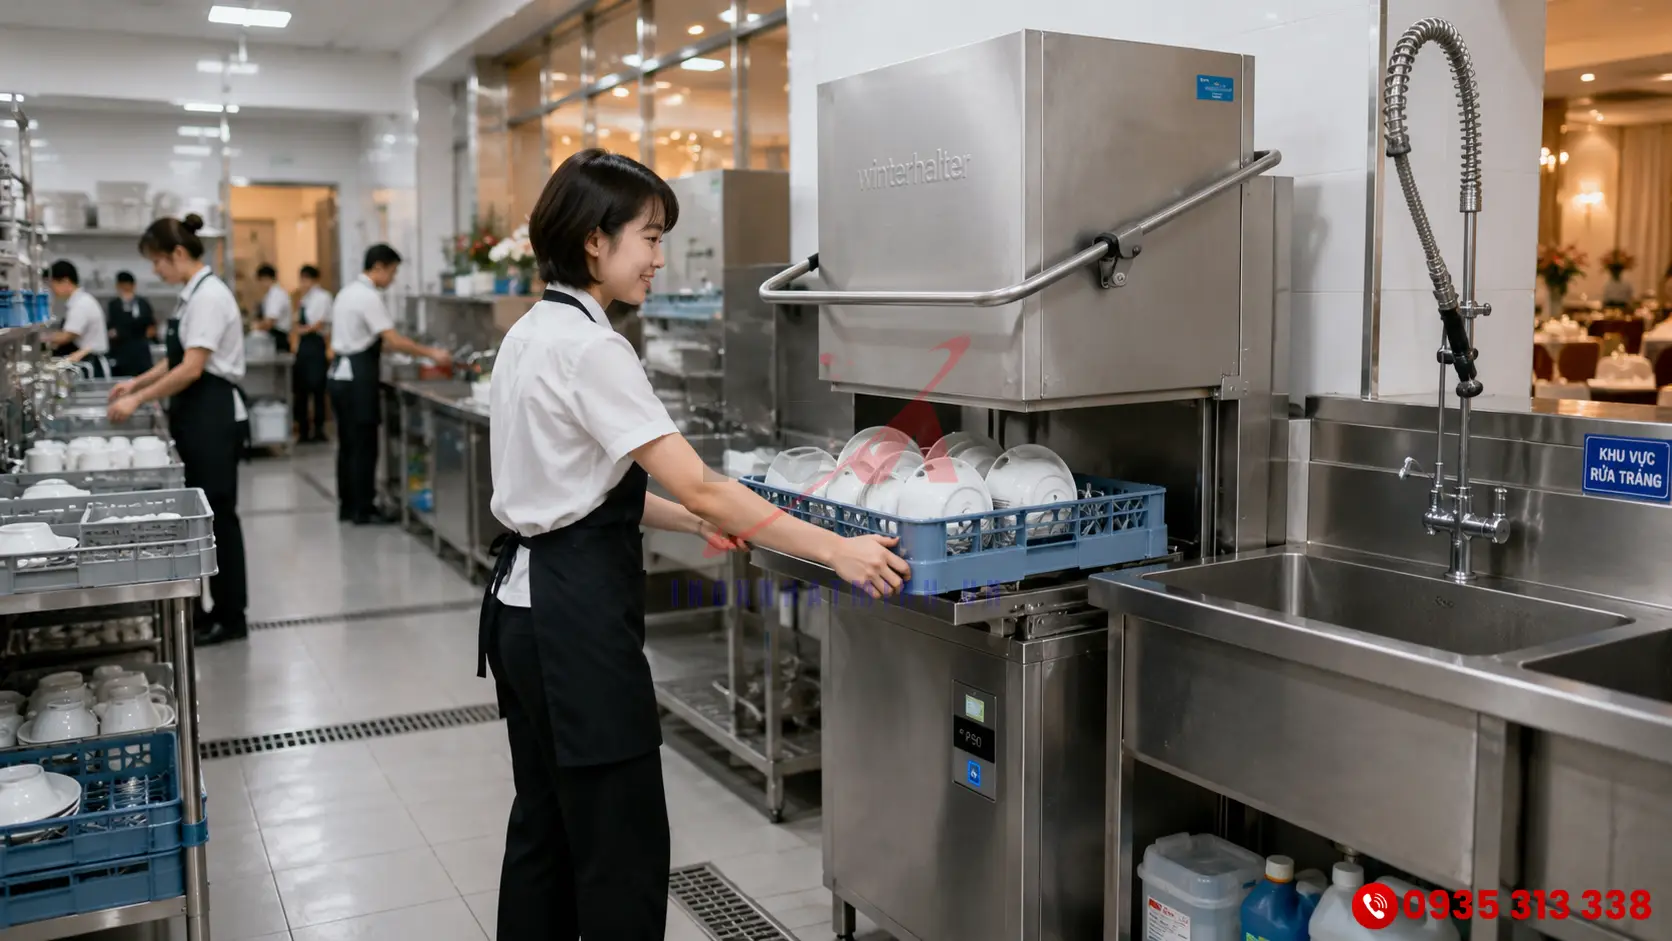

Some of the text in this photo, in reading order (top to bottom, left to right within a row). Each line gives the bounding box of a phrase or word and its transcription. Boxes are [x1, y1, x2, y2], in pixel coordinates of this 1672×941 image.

[857, 148, 972, 191] winterhalter
[1599, 447, 1656, 468] KHU VỰC
[1590, 464, 1615, 483] RỬA
